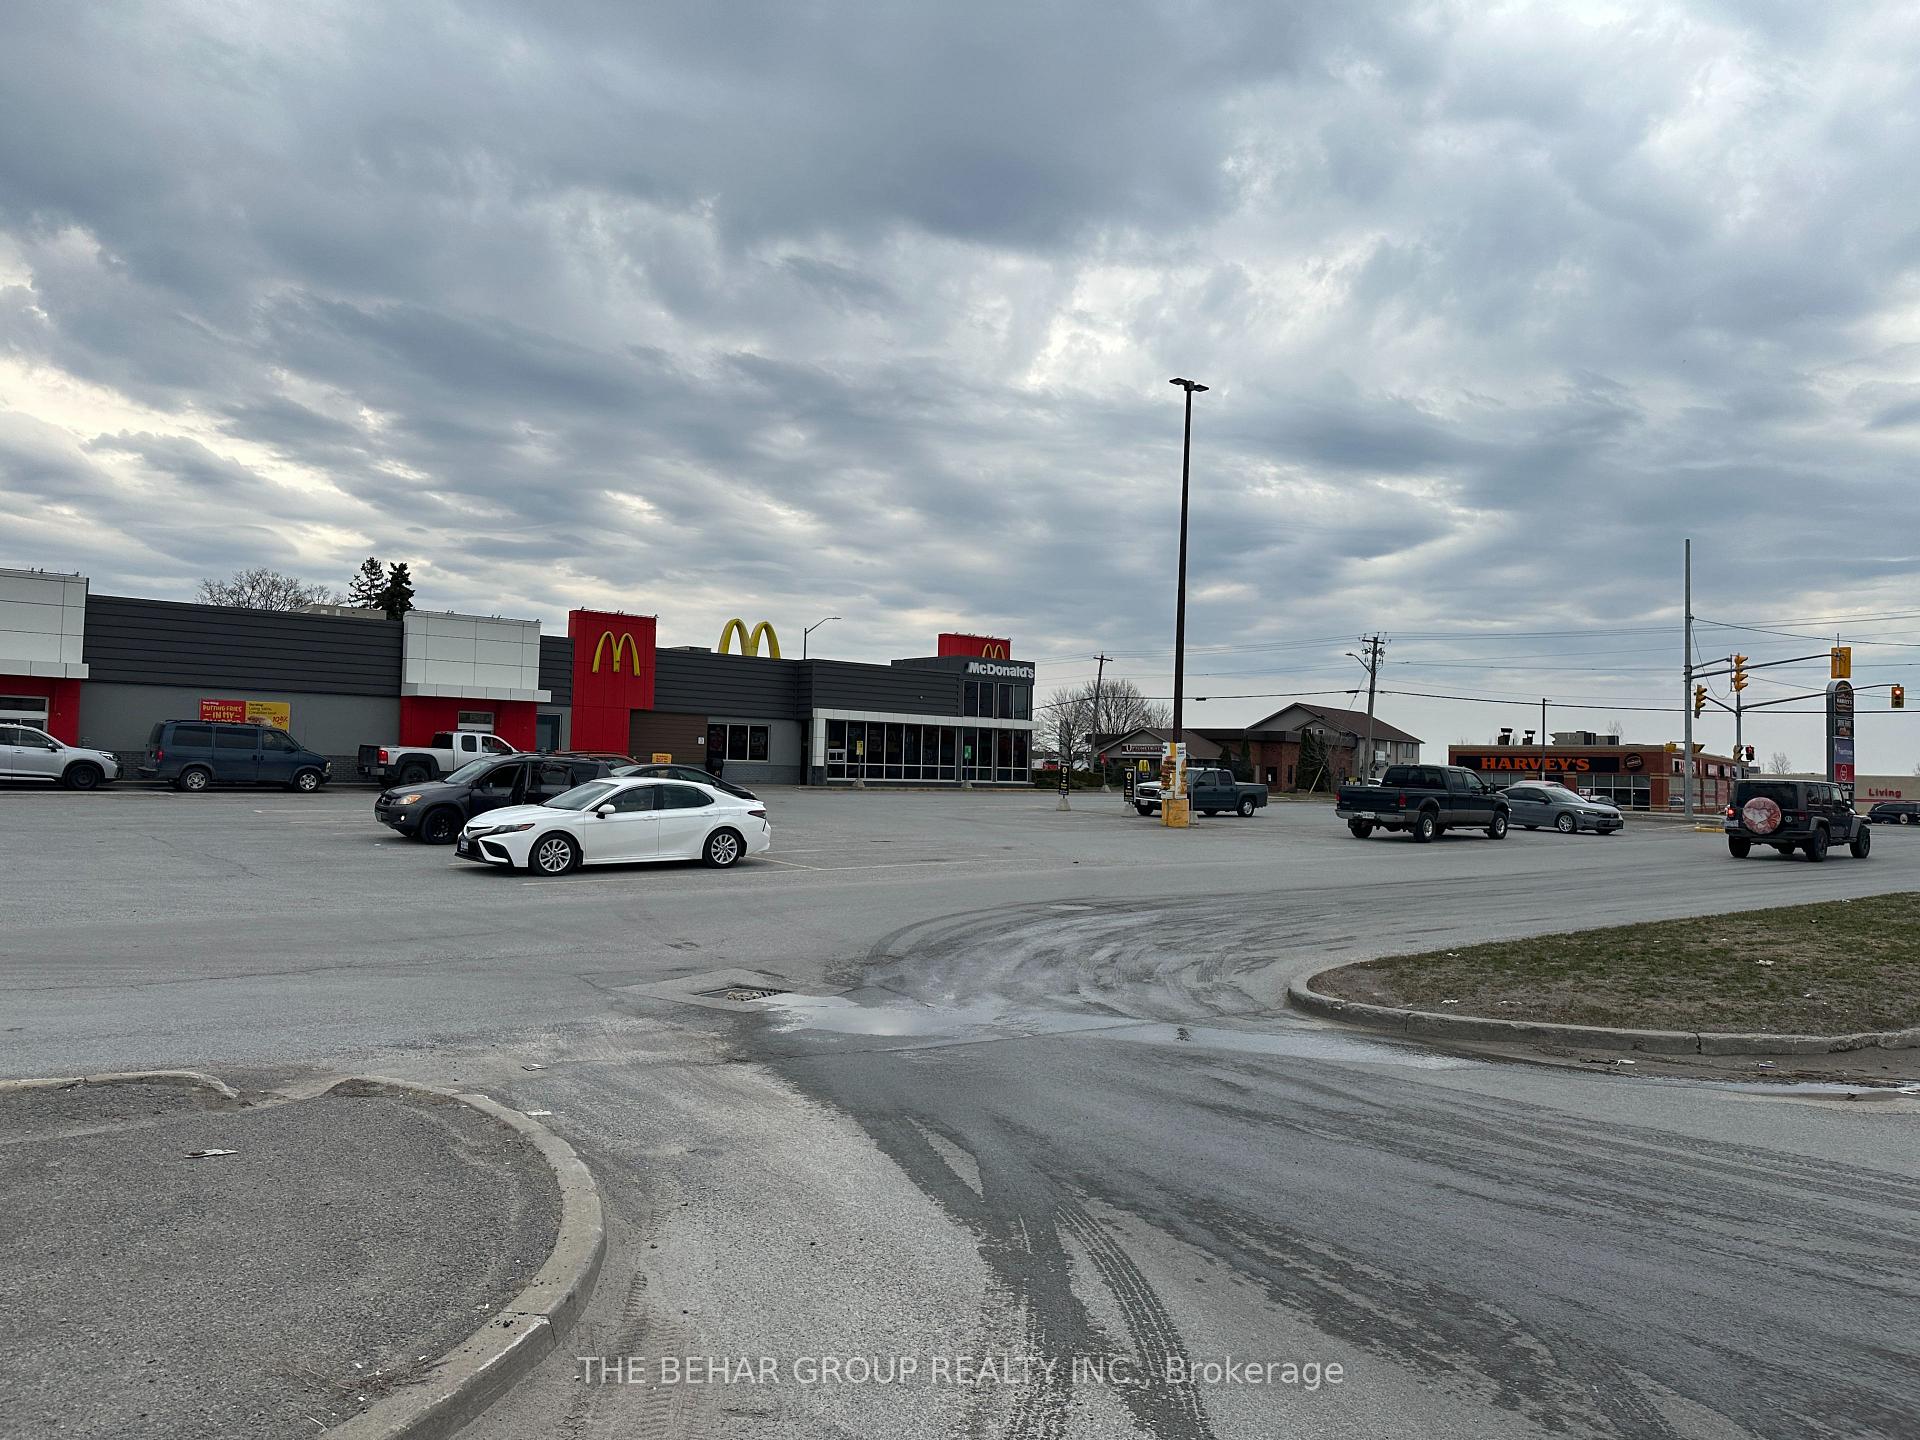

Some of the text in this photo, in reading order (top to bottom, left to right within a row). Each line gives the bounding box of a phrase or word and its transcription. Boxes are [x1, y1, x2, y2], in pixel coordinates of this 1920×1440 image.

[968, 662, 1034, 678] McDonald's
[1481, 758, 1590, 770] HARVEY'S
[1869, 788, 1902, 798] Living
